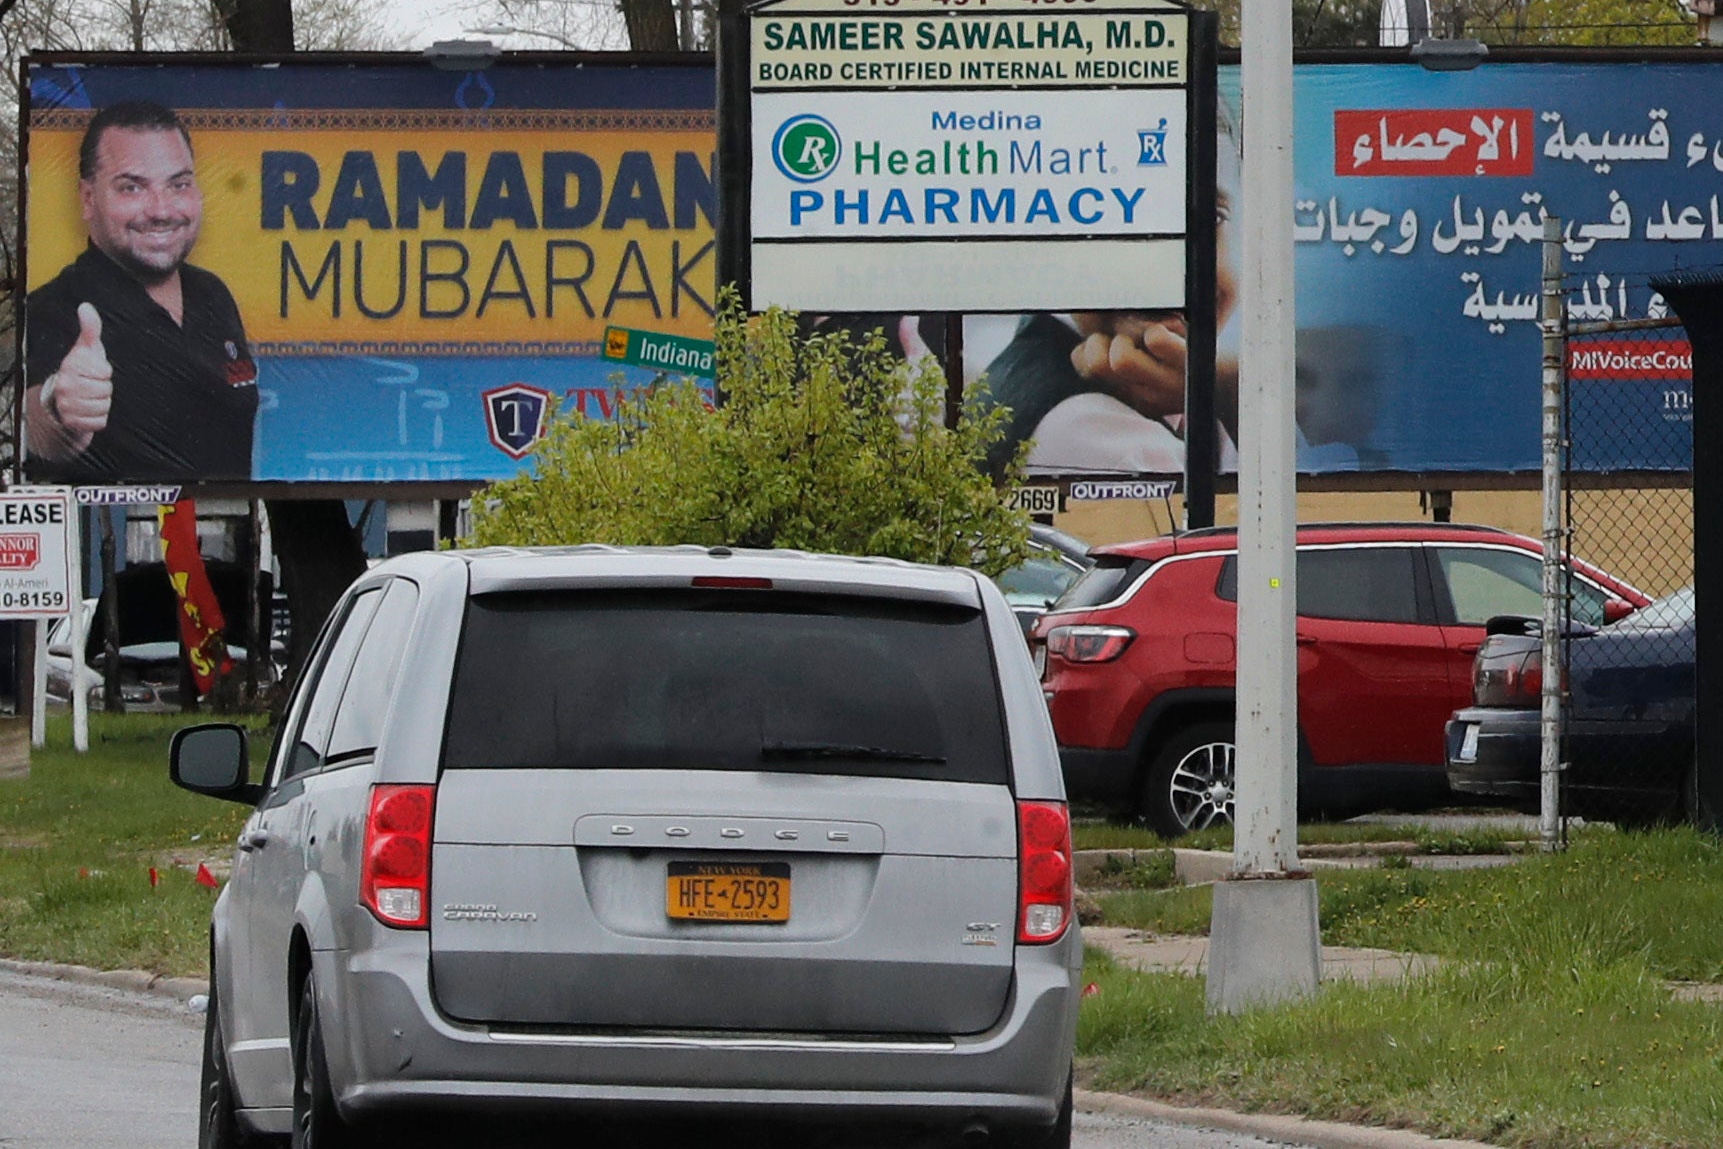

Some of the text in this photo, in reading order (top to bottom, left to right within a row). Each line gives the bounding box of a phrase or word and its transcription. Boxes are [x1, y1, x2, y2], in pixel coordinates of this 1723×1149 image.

[764, 19, 1175, 55] SAMEER SAWALHA, M.D.
[758, 60, 1179, 81] BOARD CERTIFIED INTERNAL MEDICINE
[931, 111, 1042, 130] Medina
[1353, 115, 1518, 175] الإحصاء
[1541, 108, 1669, 174] قسيمة
[261, 150, 719, 230] RAMADAN
[790, 187, 1146, 226] PHARMACY
[1294, 195, 1418, 256] وجبات
[1432, 191, 1549, 255] تمويل
[1563, 189, 1632, 262] في
[280, 239, 716, 319] MUBARAK
[640, 337, 712, 370] Indiana
[1572, 351, 1693, 370] MIVoiceCou
[77, 489, 175, 503] OUTFRONT
[1009, 489, 1055, 512] 2669
[1074, 484, 1170, 498] OUTFRONT
[0, 504, 63, 525] EASE
[611, 824, 849, 841] DODGE
